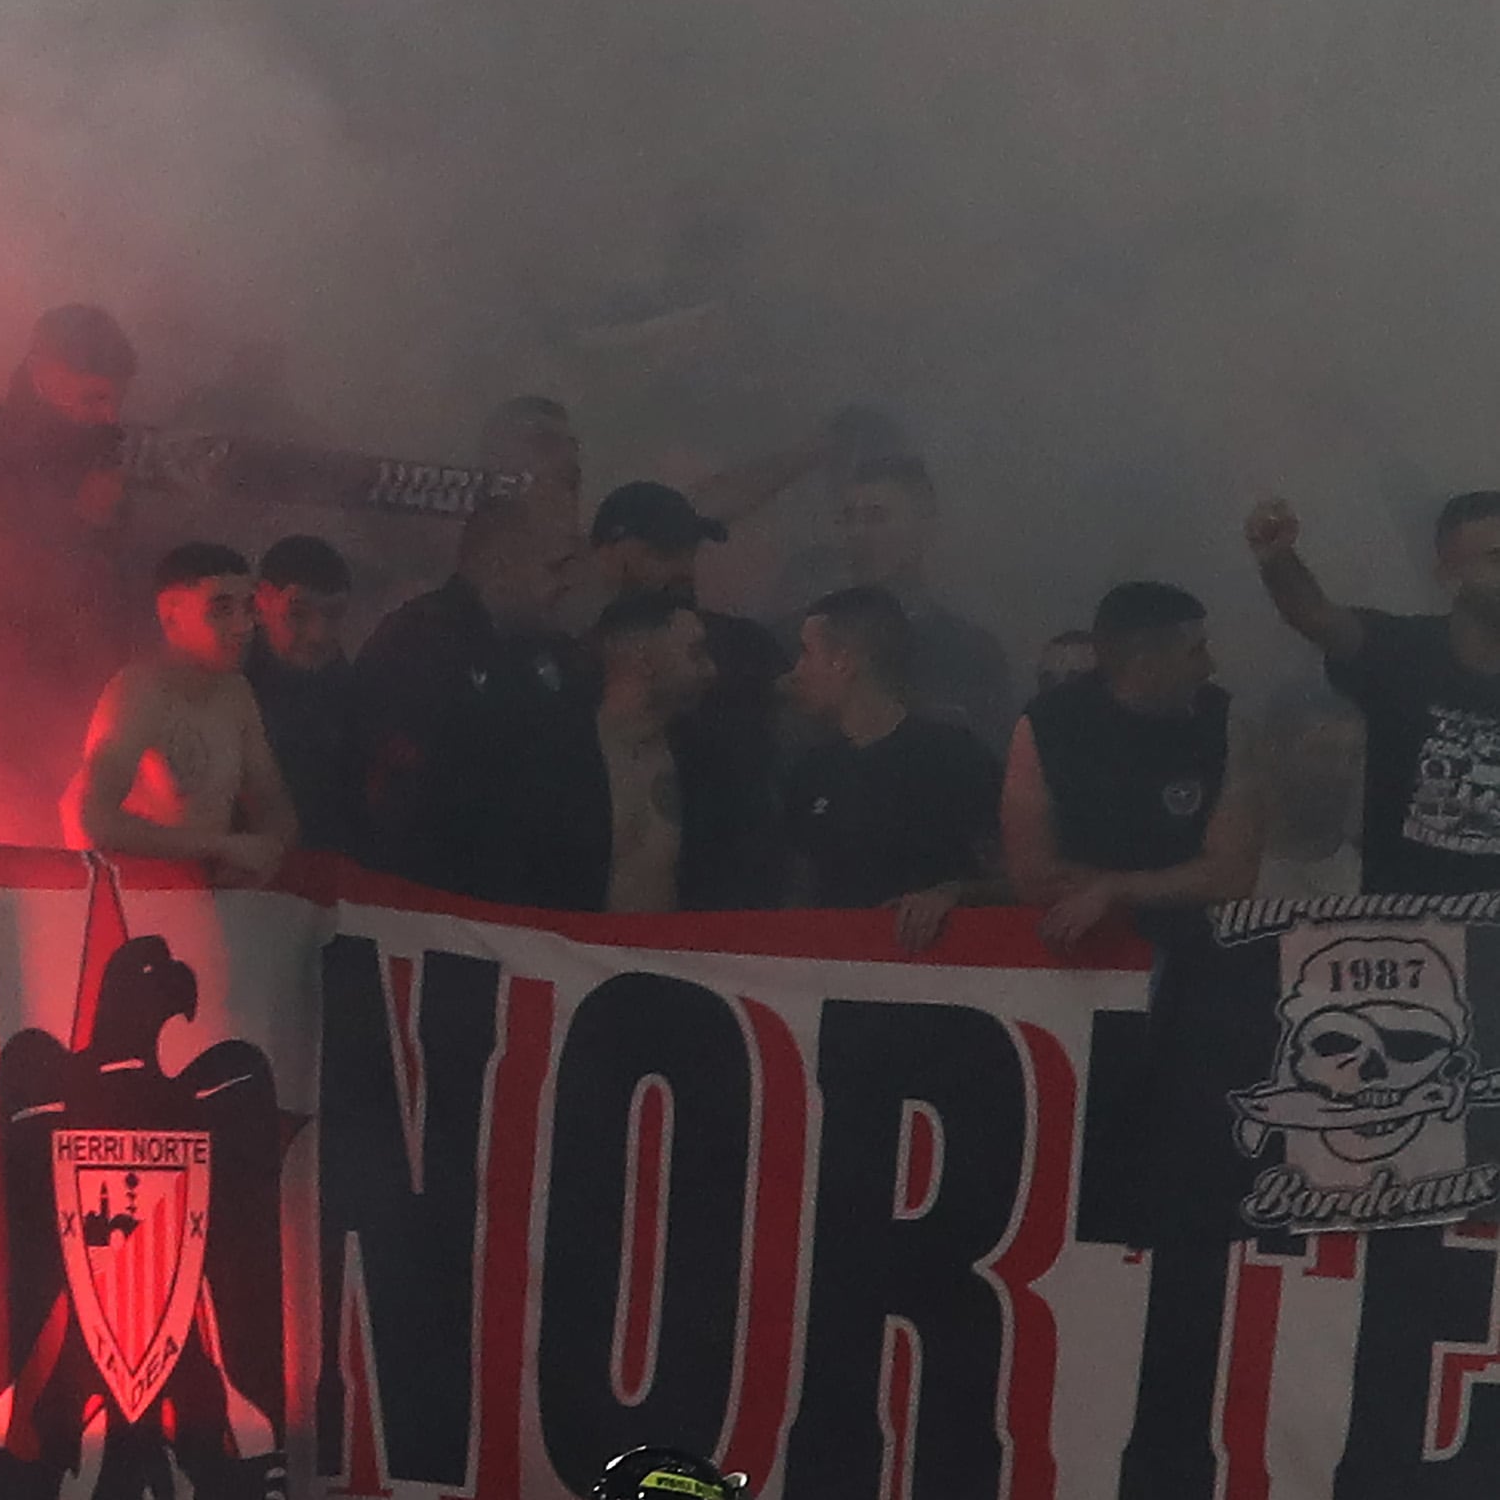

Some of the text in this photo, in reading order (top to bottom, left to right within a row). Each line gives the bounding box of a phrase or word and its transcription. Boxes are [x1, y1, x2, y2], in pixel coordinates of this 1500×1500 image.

[1326, 957, 1426, 993] 1987
[57, 1134, 208, 1165] HERRI NORTE
[1240, 1164, 1500, 1227] Bordeaux
